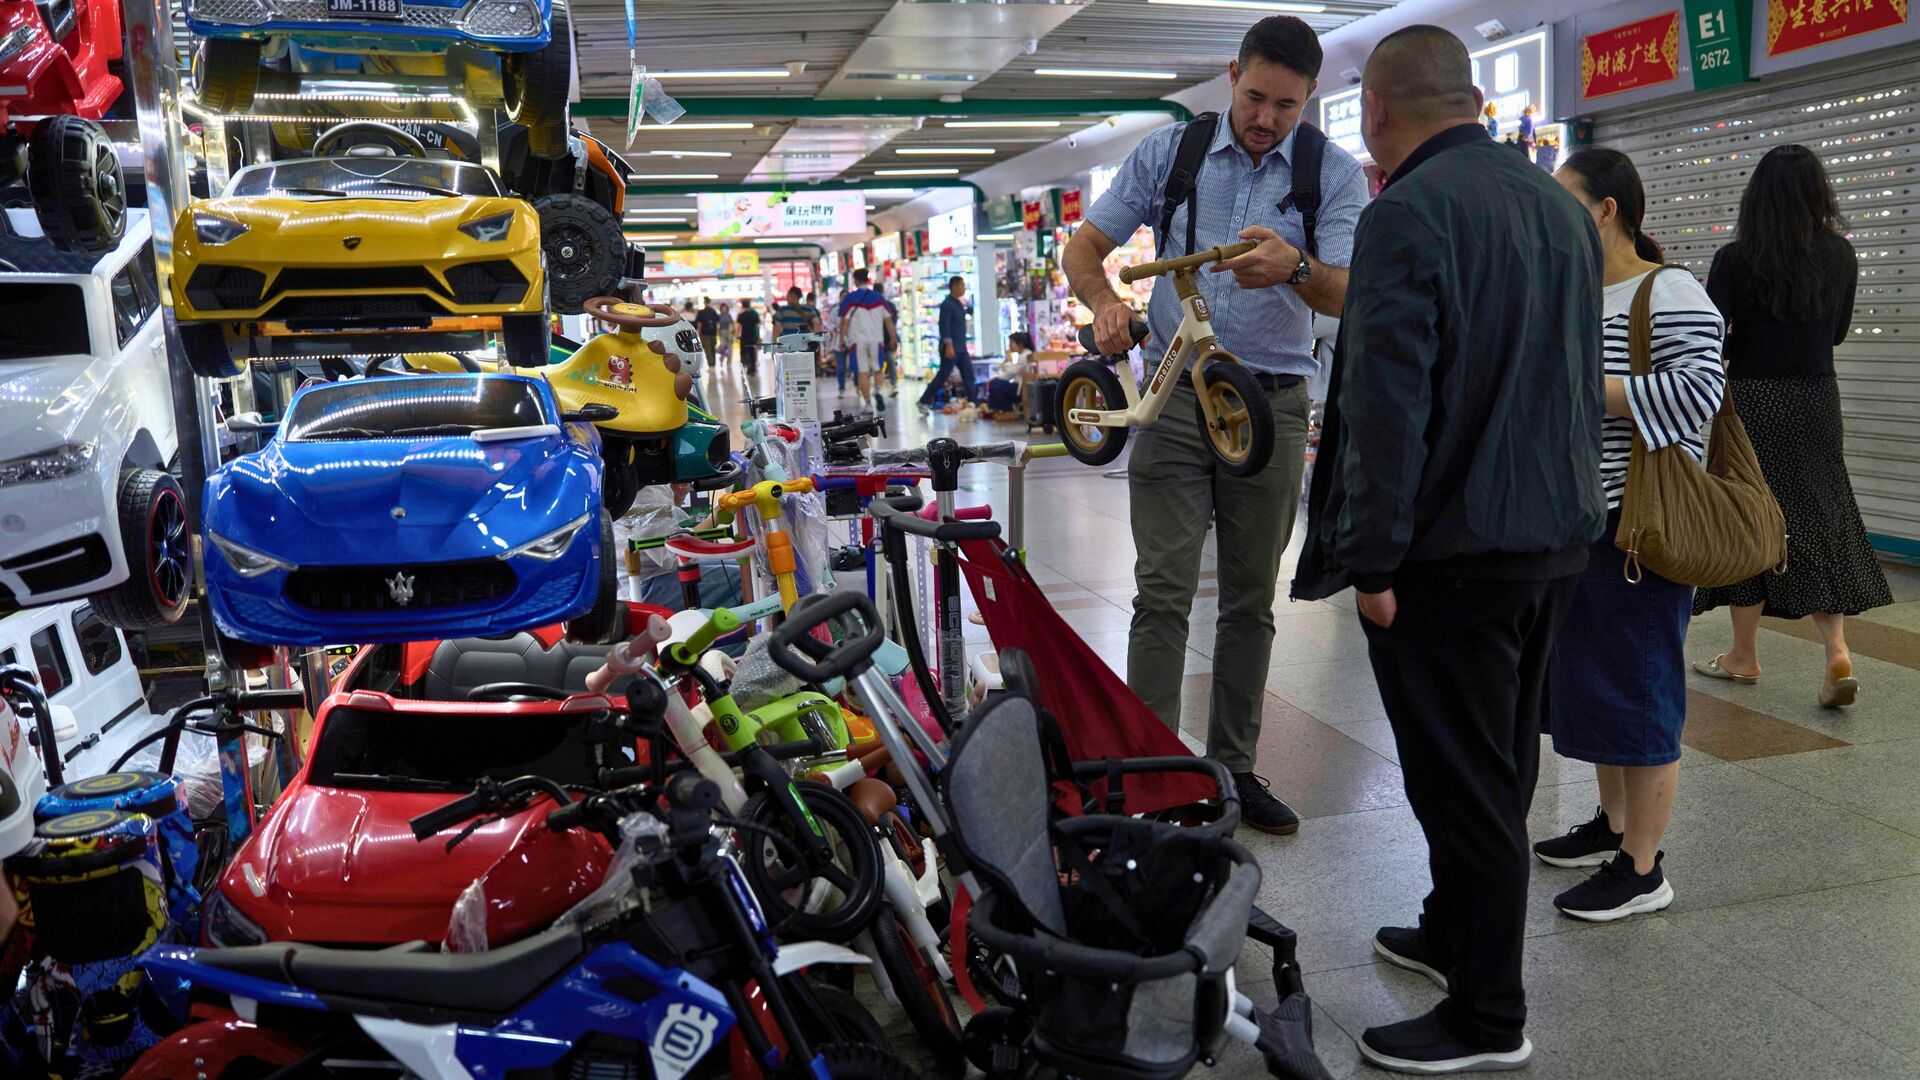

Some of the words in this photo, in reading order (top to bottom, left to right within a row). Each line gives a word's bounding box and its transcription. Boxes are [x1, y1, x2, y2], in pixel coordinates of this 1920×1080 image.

[331, 0, 397, 11] JM-1188
[1698, 9, 1726, 40] E1
[1596, 37, 1662, 78] 财源广进
[1700, 48, 1731, 70] 2672
[1158, 349, 1178, 384] meloto
